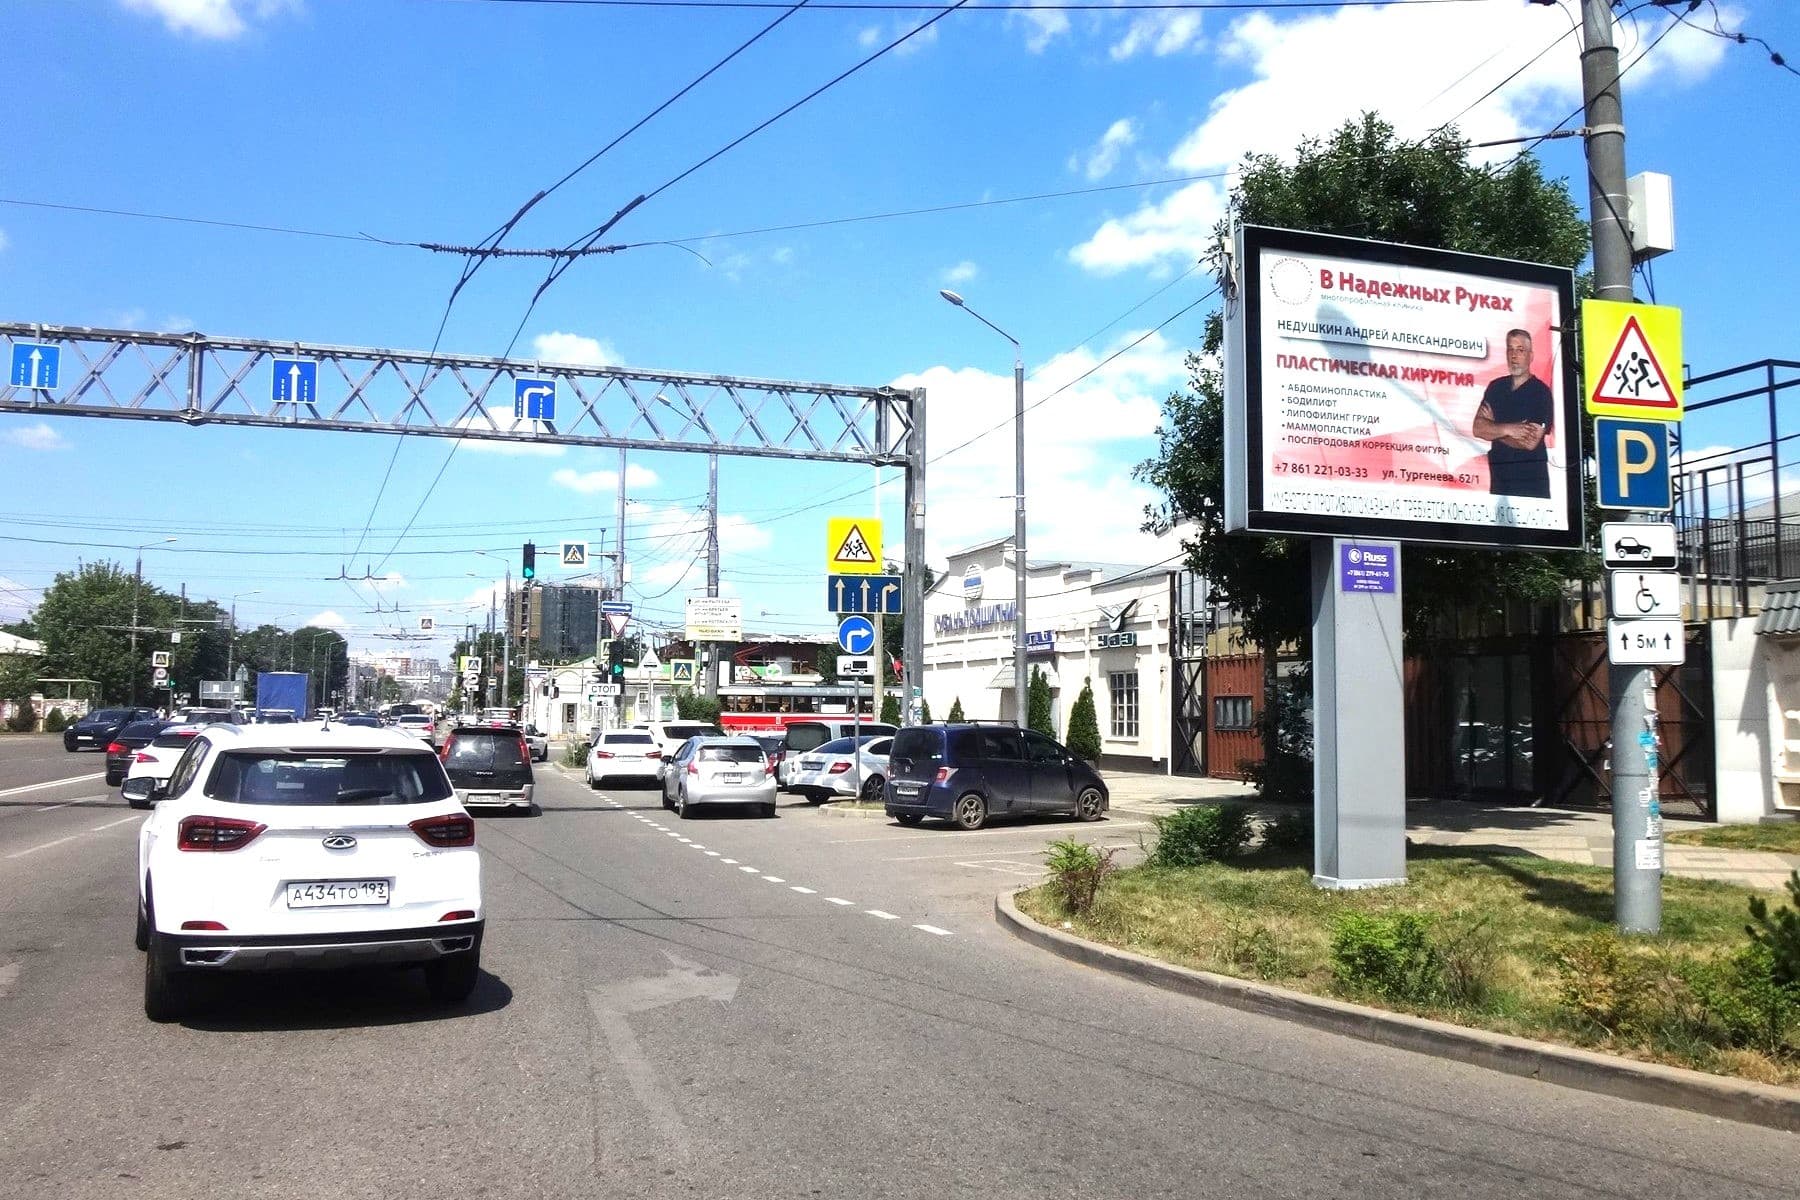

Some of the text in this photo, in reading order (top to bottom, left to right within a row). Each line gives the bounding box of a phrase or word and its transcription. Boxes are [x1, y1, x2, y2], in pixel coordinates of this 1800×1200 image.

[1320, 269, 1334, 289] В
[1339, 271, 1451, 304] Надежных
[1455, 286, 1514, 312] Руках
[1277, 319, 1483, 351] НЕДУШКИН АНДРЕЙ АЛЕКСАНДРОВИЧ
[1276, 353, 1474, 387] ПЛАСТИЧЕСКАЯ ХИРУРГИЯ
[1287, 383, 1387, 400] АБДОМИНОПЛАСТИКА
[1287, 396, 1337, 408] БОДИЛИФТ
[1286, 409, 1380, 424] ЛИПОФИЛИНГ ГРУДИ
[1286, 422, 1371, 436] МАММОПЛАСТИКА
[1287, 435, 1450, 455] ПОСЛЕРОДОВАЯ КОРРЕКЦИЯ ФИГУРЫ
[1275, 462, 1288, 473] +7
[1291, 463, 1310, 474] 861
[1314, 464, 1368, 478] 221-03-33
[1382, 469, 1398, 480] ул.
[1458, 473, 1480, 485] 62/1
[1616, 429, 1657, 498] P
[1363, 551, 1388, 562] Russ
[591, 685, 616, 693] СТОП
[293, 882, 385, 902] А434ТО 193
